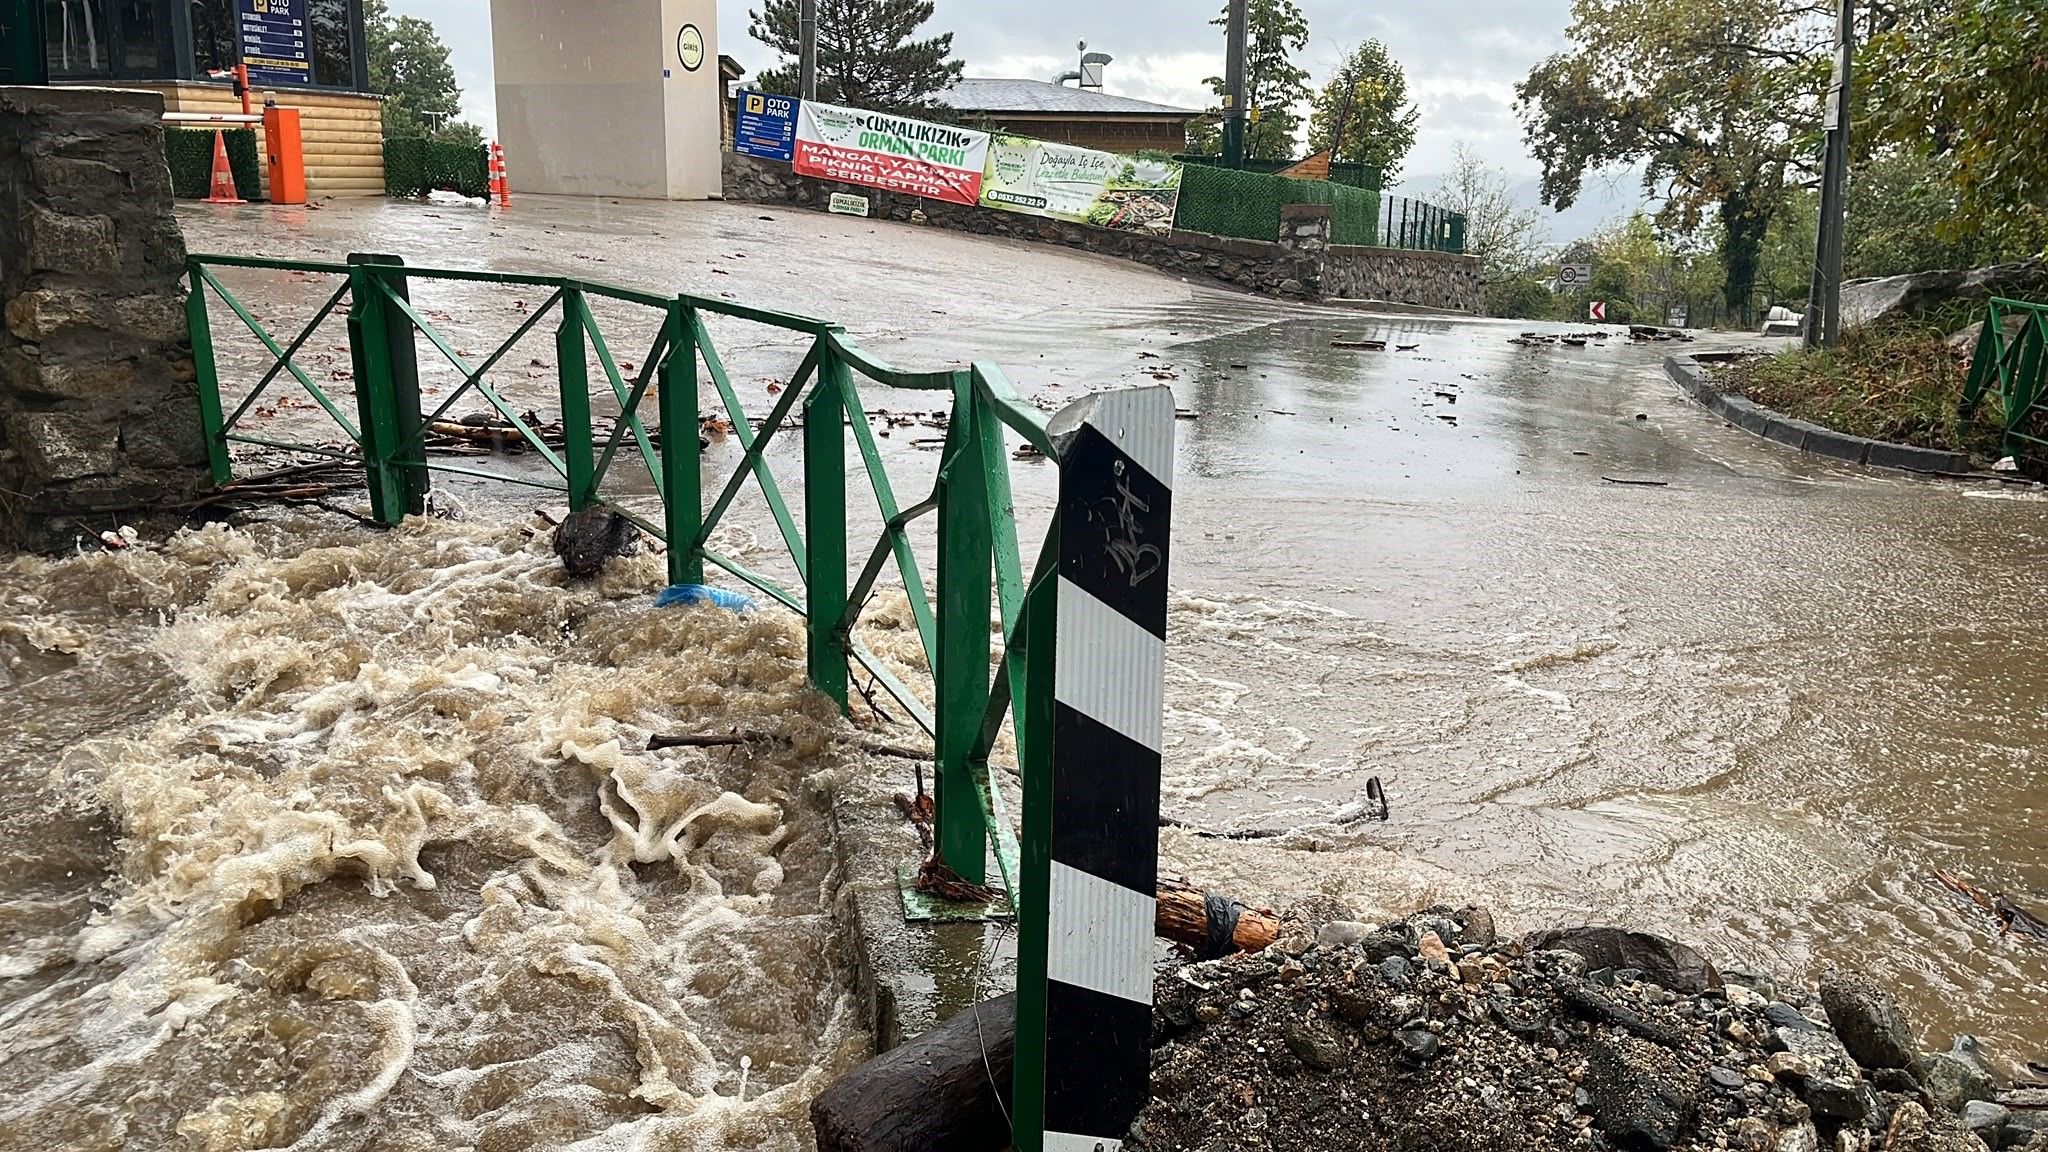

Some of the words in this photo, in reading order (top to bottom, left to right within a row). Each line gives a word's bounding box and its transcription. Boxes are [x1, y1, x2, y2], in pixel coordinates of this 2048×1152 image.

[270, 7, 290, 16] PARK
[766, 107, 790, 119] PARK
[767, 98, 791, 110] OTO
[866, 115, 962, 148] CUMALIKIZIK
[858, 131, 914, 157] ORMAN
[918, 142, 966, 167] PARKI
[1040, 151, 1076, 169] Doğayla
[801, 144, 885, 165] MANGAL
[889, 159, 973, 183] YAKMAK
[808, 155, 875, 174] PİKNİK
[878, 165, 962, 190] YAPMAK
[825, 168, 941, 196] SERBESTTİR
[1564, 271, 1574, 279] 30
